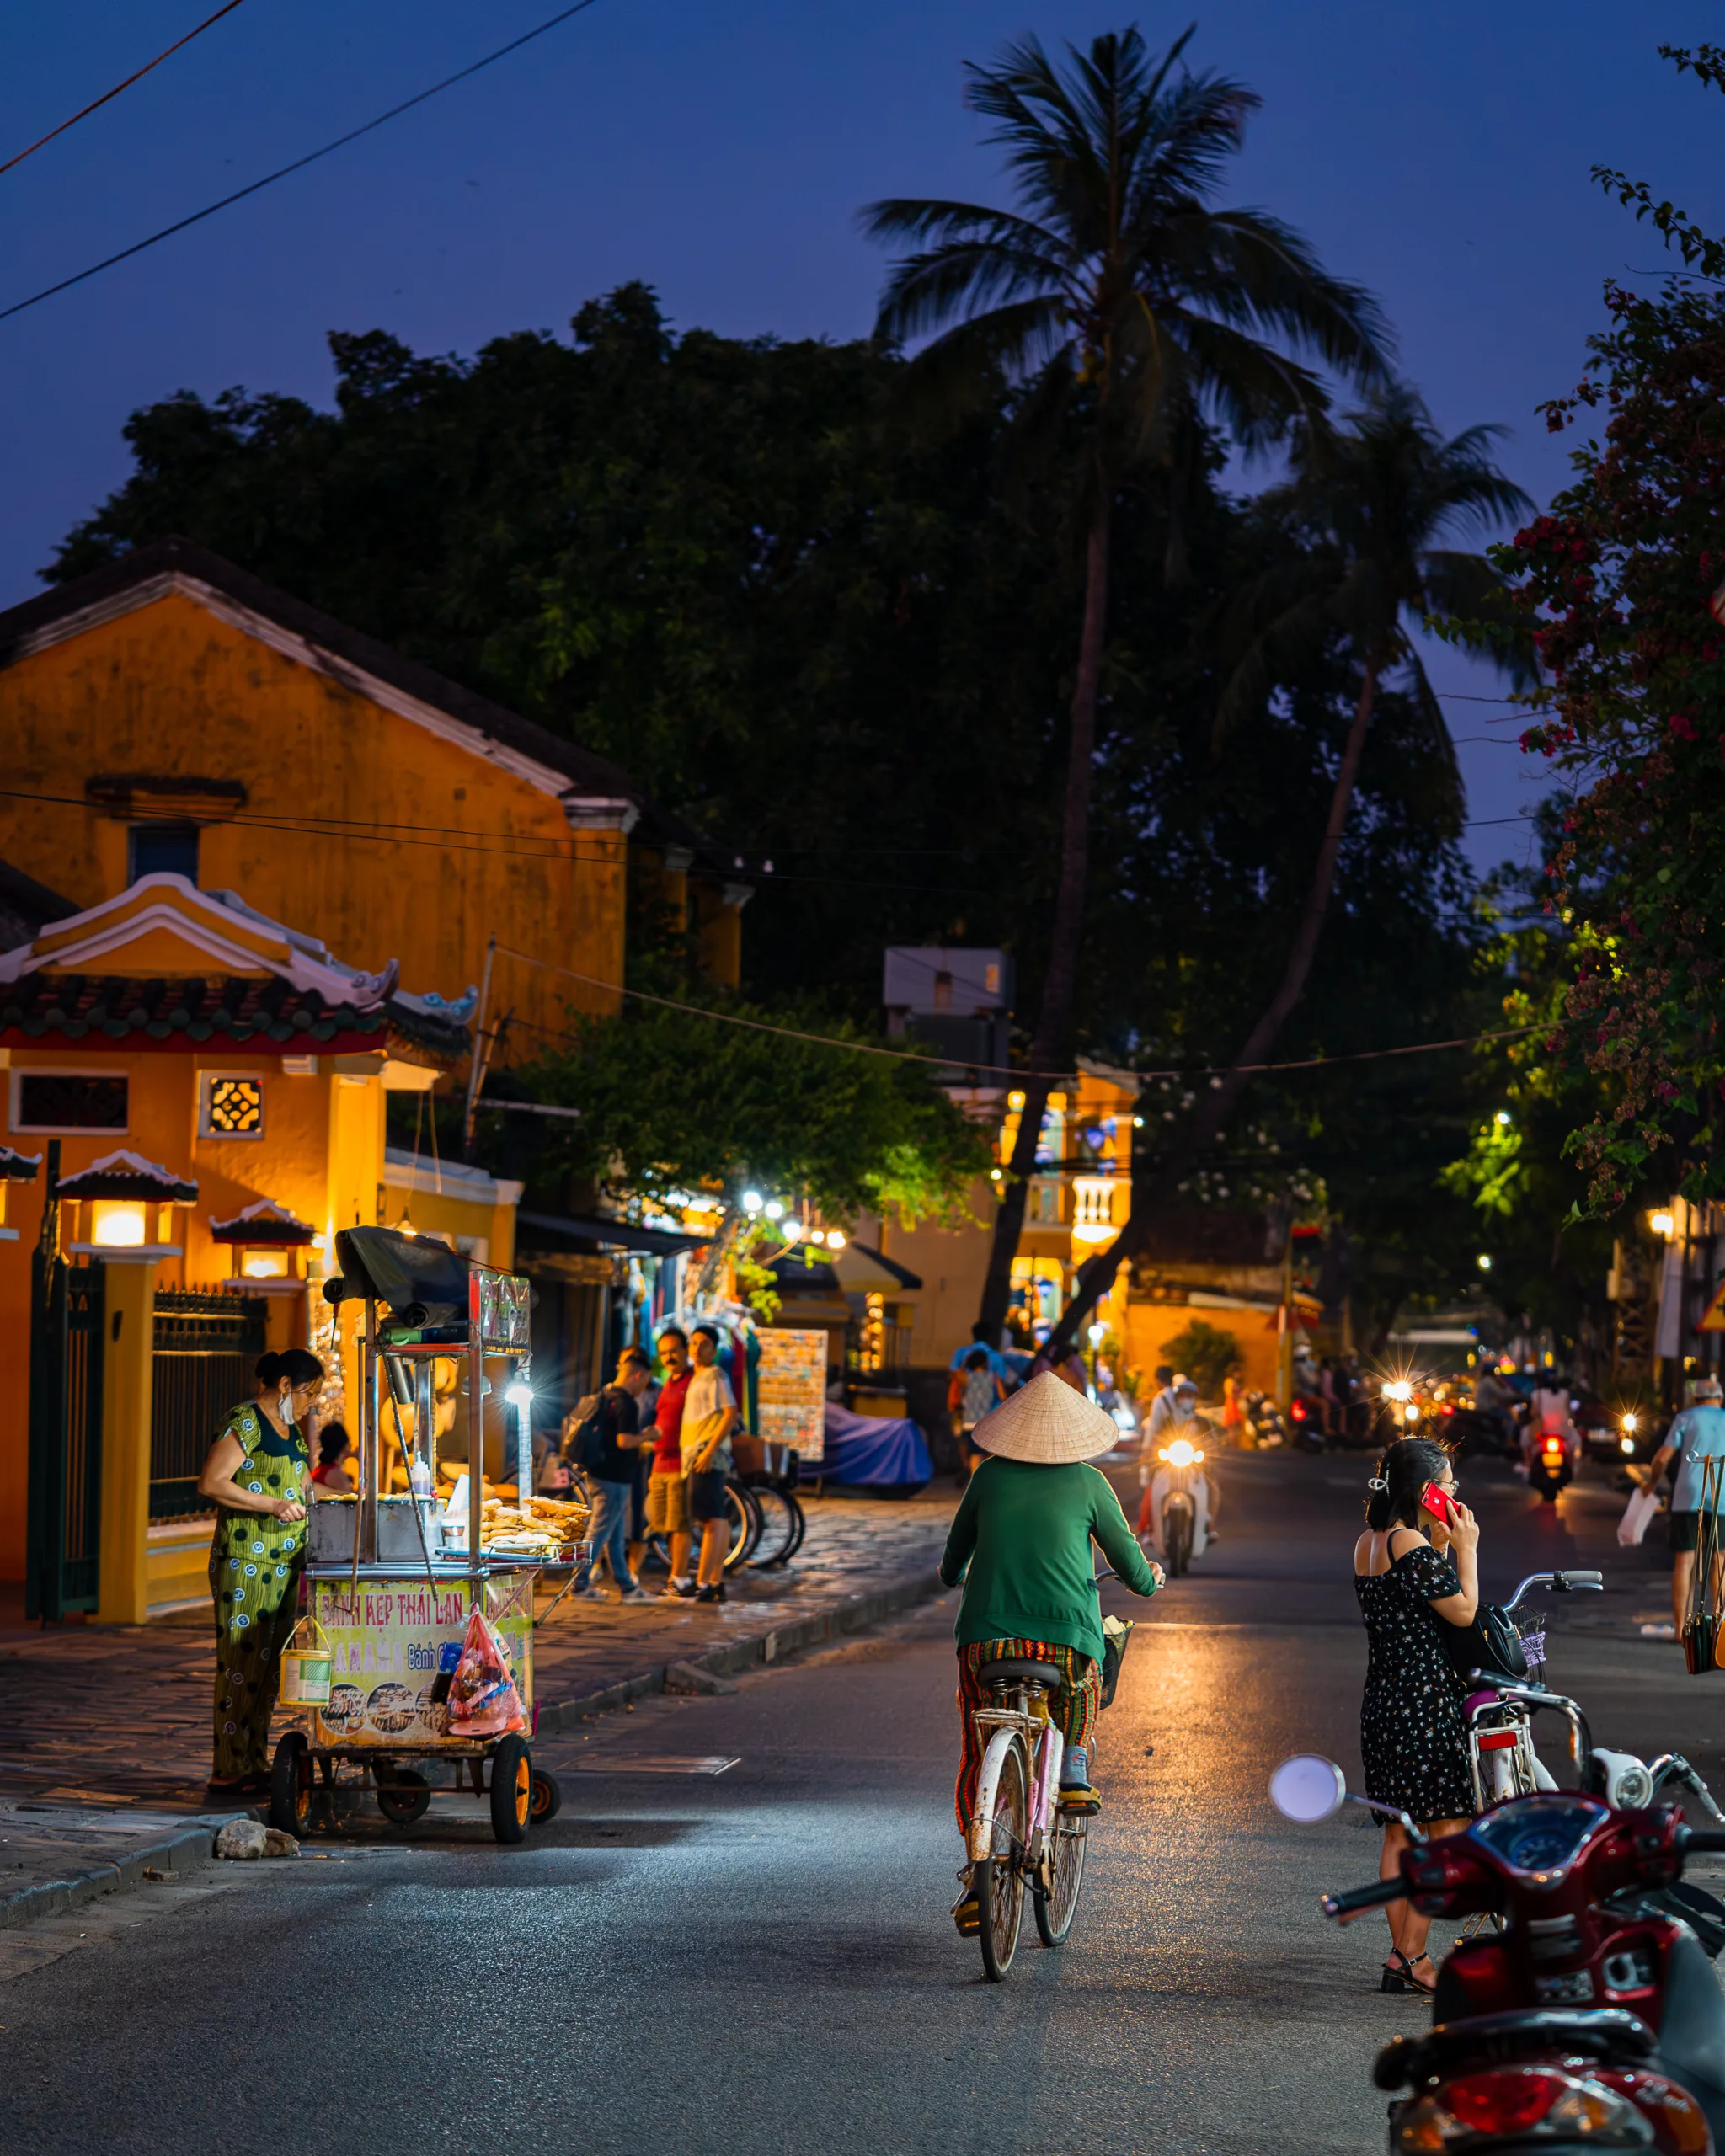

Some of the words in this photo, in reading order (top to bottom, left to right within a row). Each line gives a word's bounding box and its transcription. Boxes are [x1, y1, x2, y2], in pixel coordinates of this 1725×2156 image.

[397, 1587, 431, 1625] THÁI
[435, 1593, 463, 1625] LAN
[408, 1641, 437, 1671] Bánh
